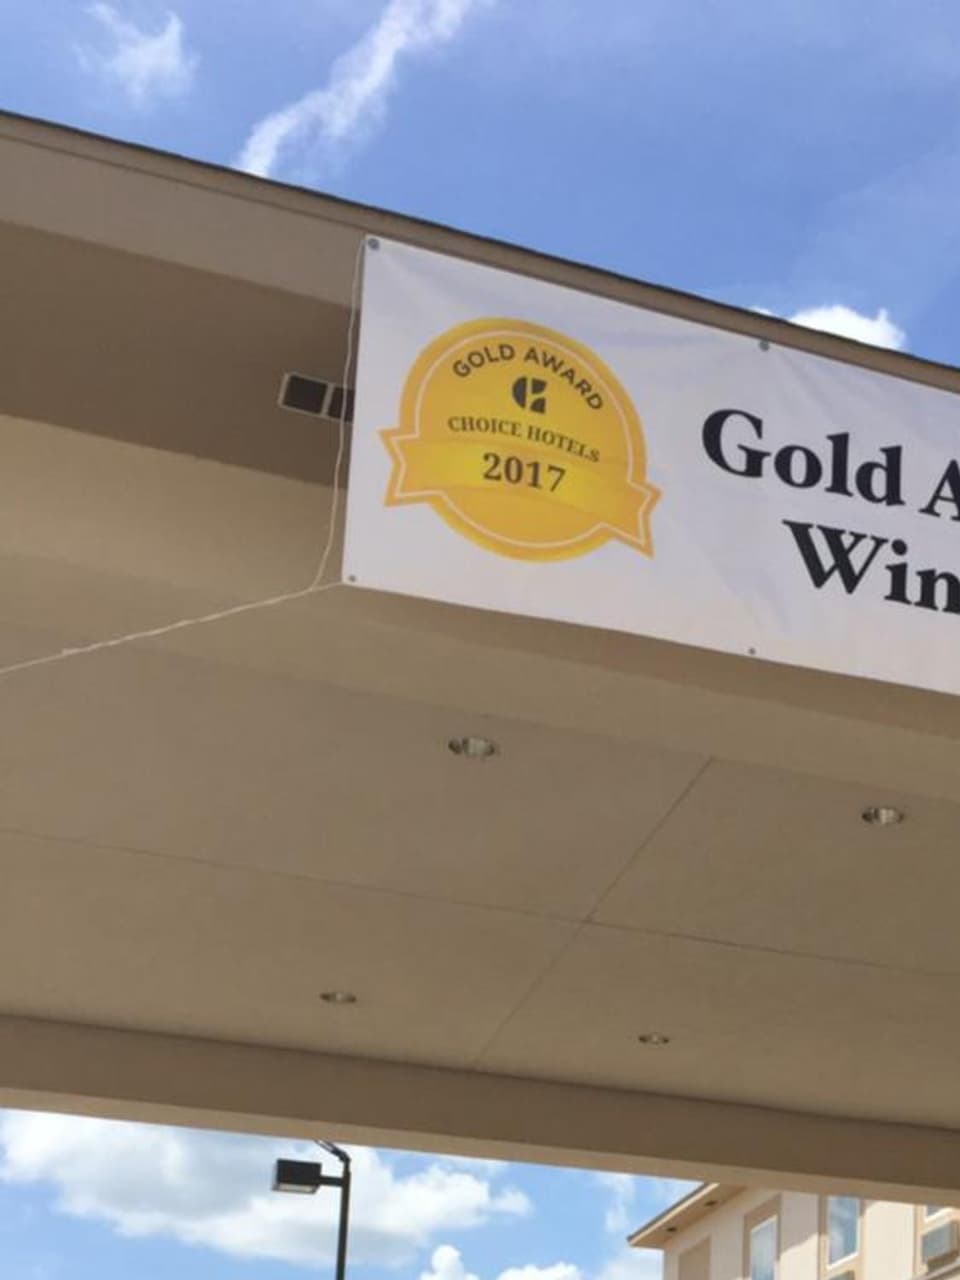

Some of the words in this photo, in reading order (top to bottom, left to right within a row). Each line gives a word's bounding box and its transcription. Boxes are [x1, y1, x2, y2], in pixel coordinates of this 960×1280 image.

[452, 343, 516, 378] GOLD
[523, 346, 604, 412] AWARD
[447, 416, 522, 440] CHOICE
[526, 425, 601, 463] HOTELS
[701, 408, 905, 507] Gold
[482, 452, 566, 493] 2017
